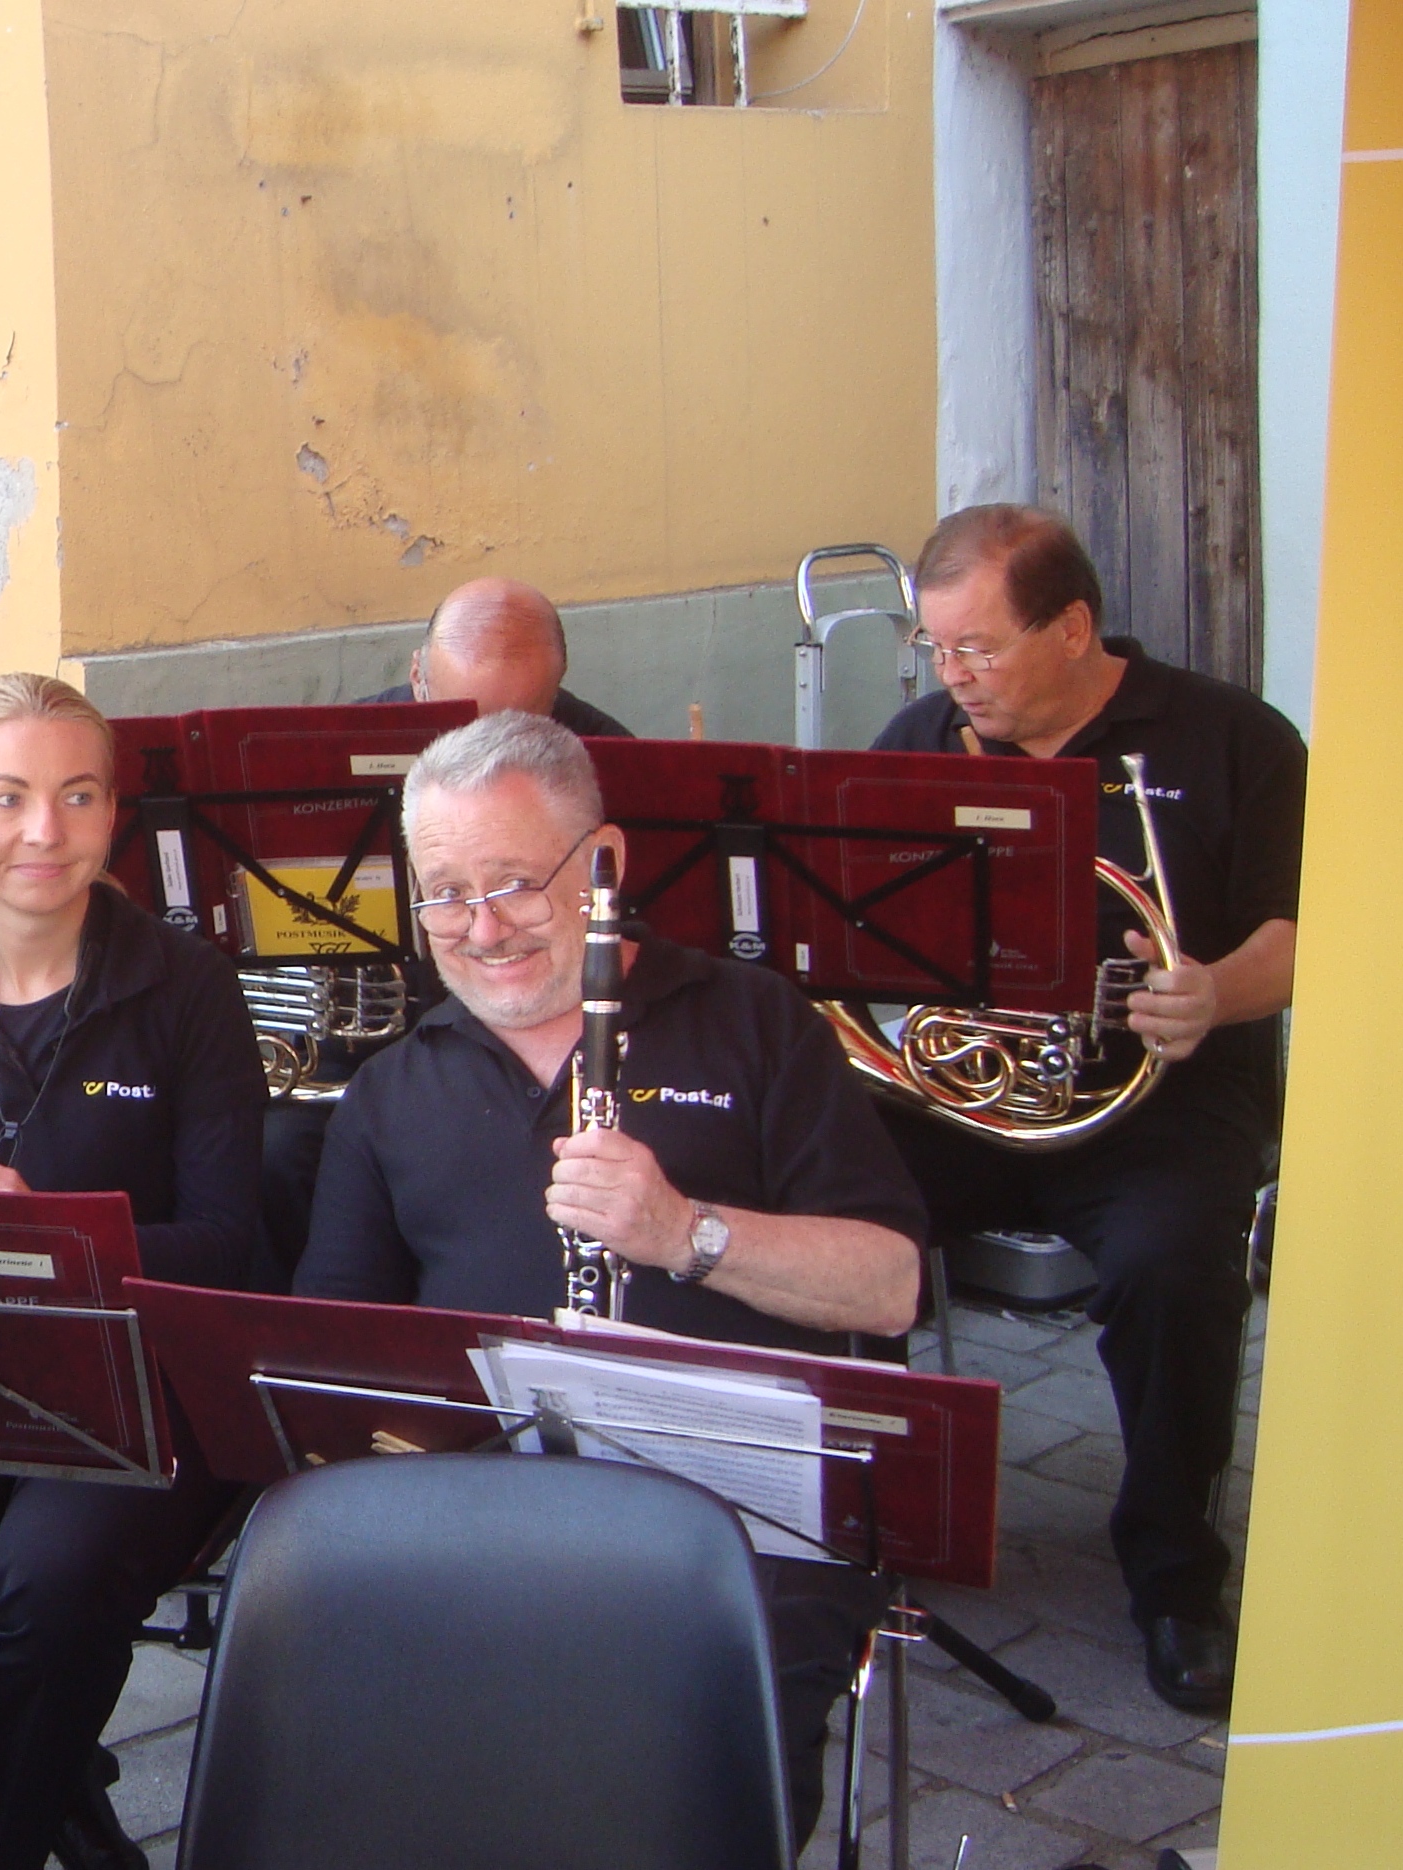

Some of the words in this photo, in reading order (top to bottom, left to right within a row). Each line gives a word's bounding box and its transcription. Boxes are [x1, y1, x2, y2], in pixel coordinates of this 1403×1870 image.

[1124, 783, 1182, 800] Pst.at
[293, 797, 379, 815] KONZERTM
[276, 930, 347, 940] POSTMUSIK
[106, 1081, 157, 1099] Post.
[660, 1087, 732, 1109] Post.at
